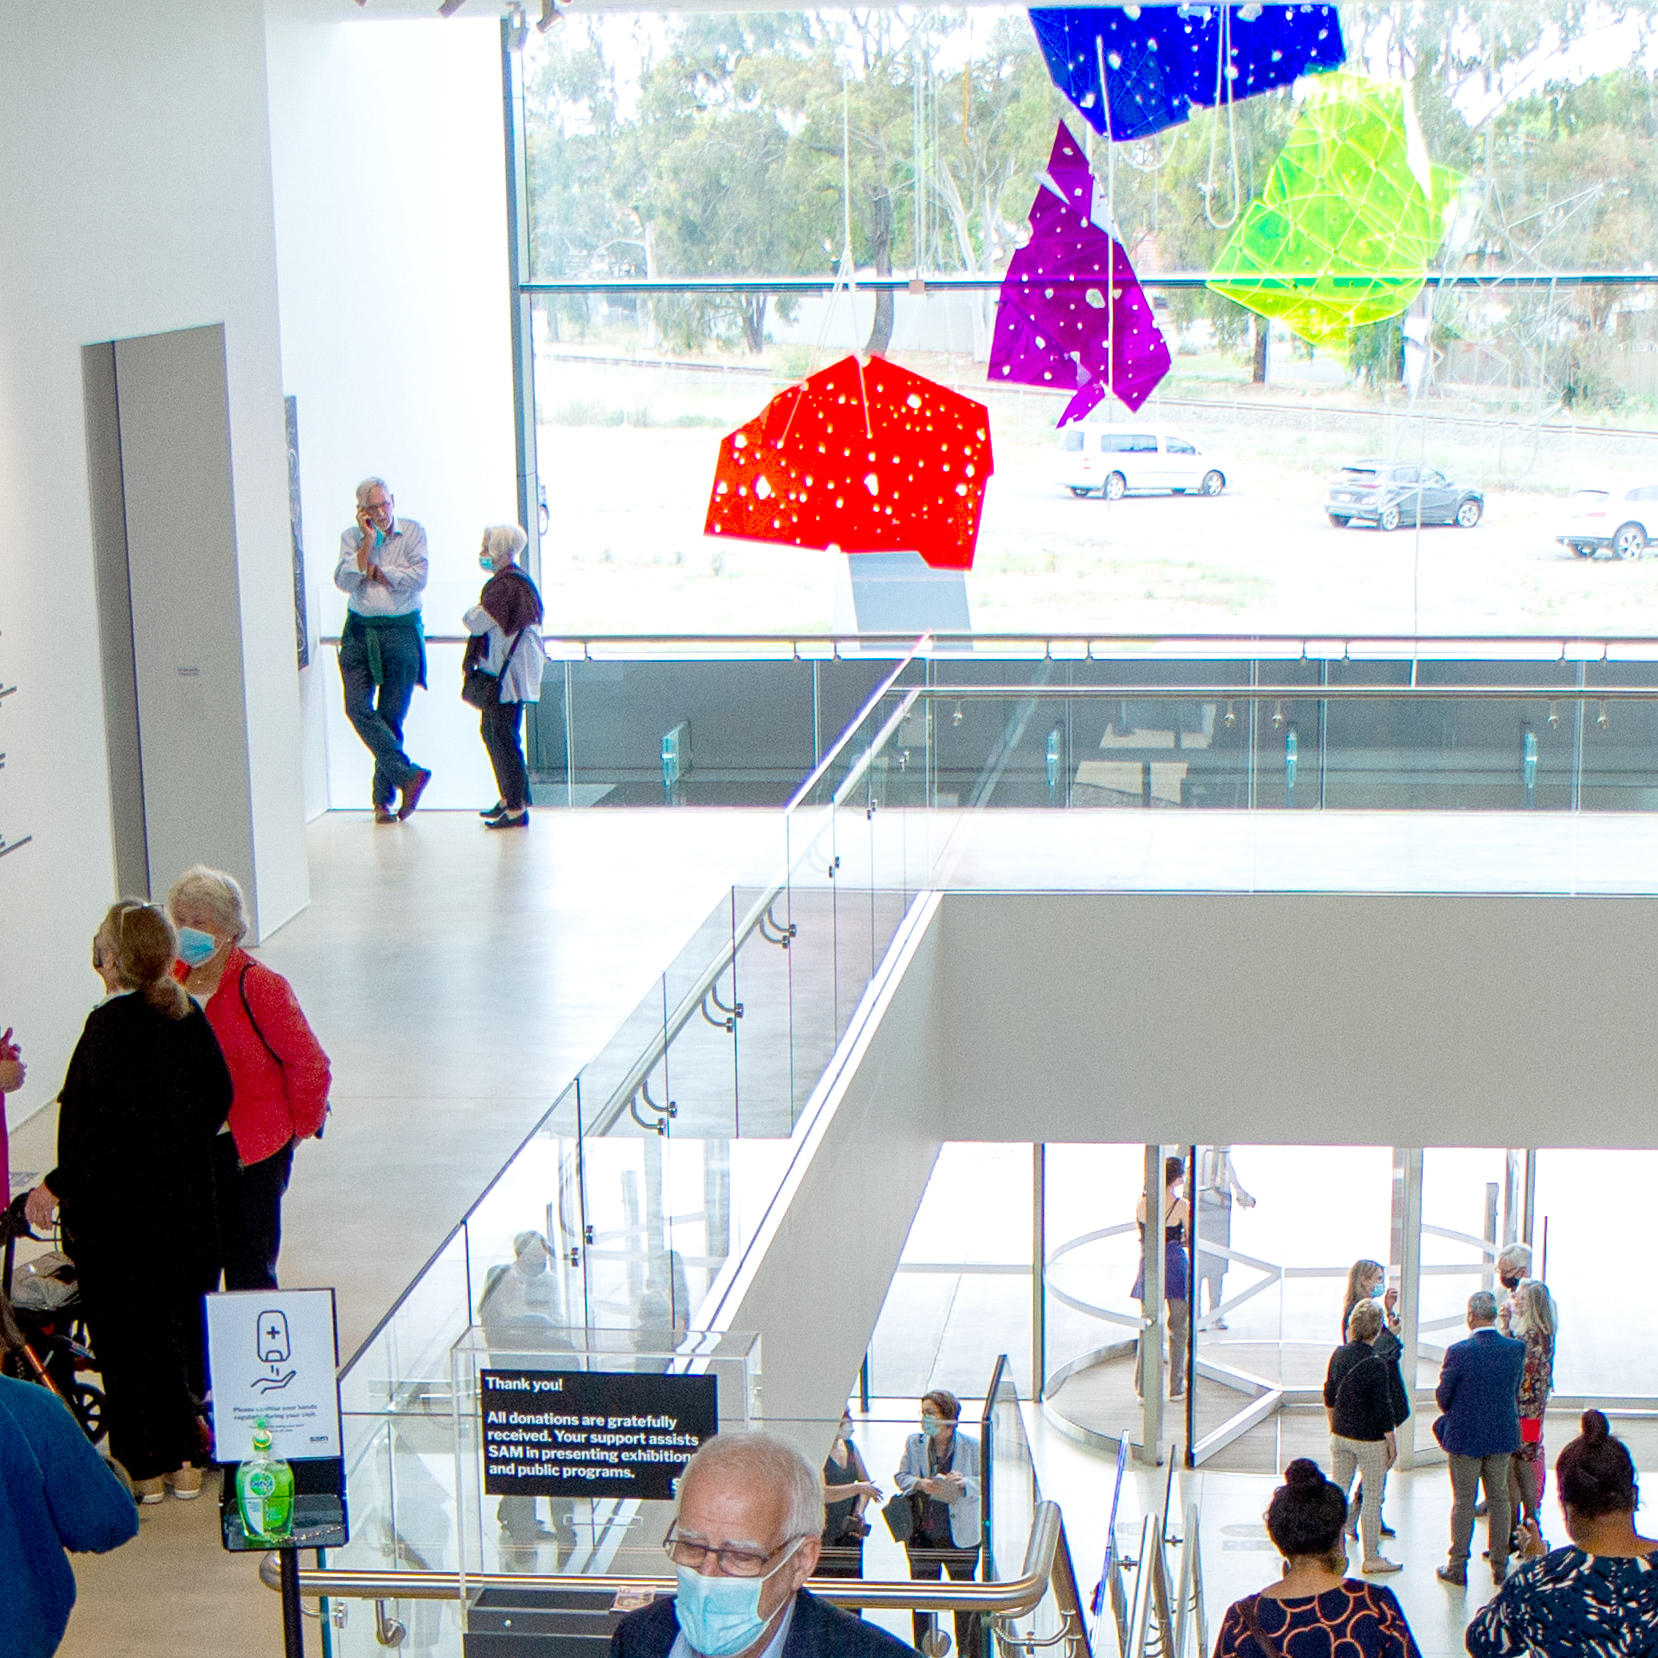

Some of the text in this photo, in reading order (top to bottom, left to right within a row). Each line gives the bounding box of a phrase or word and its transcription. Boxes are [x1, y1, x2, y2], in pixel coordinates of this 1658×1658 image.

[485, 1377, 563, 1392] Thank you!
[487, 1411, 677, 1431] All donations are gratefully
[487, 1429, 699, 1447] received. Your support assists
[488, 1446, 695, 1463] SAM in presenting exhibition
[489, 1463, 635, 1480] and public programs.
